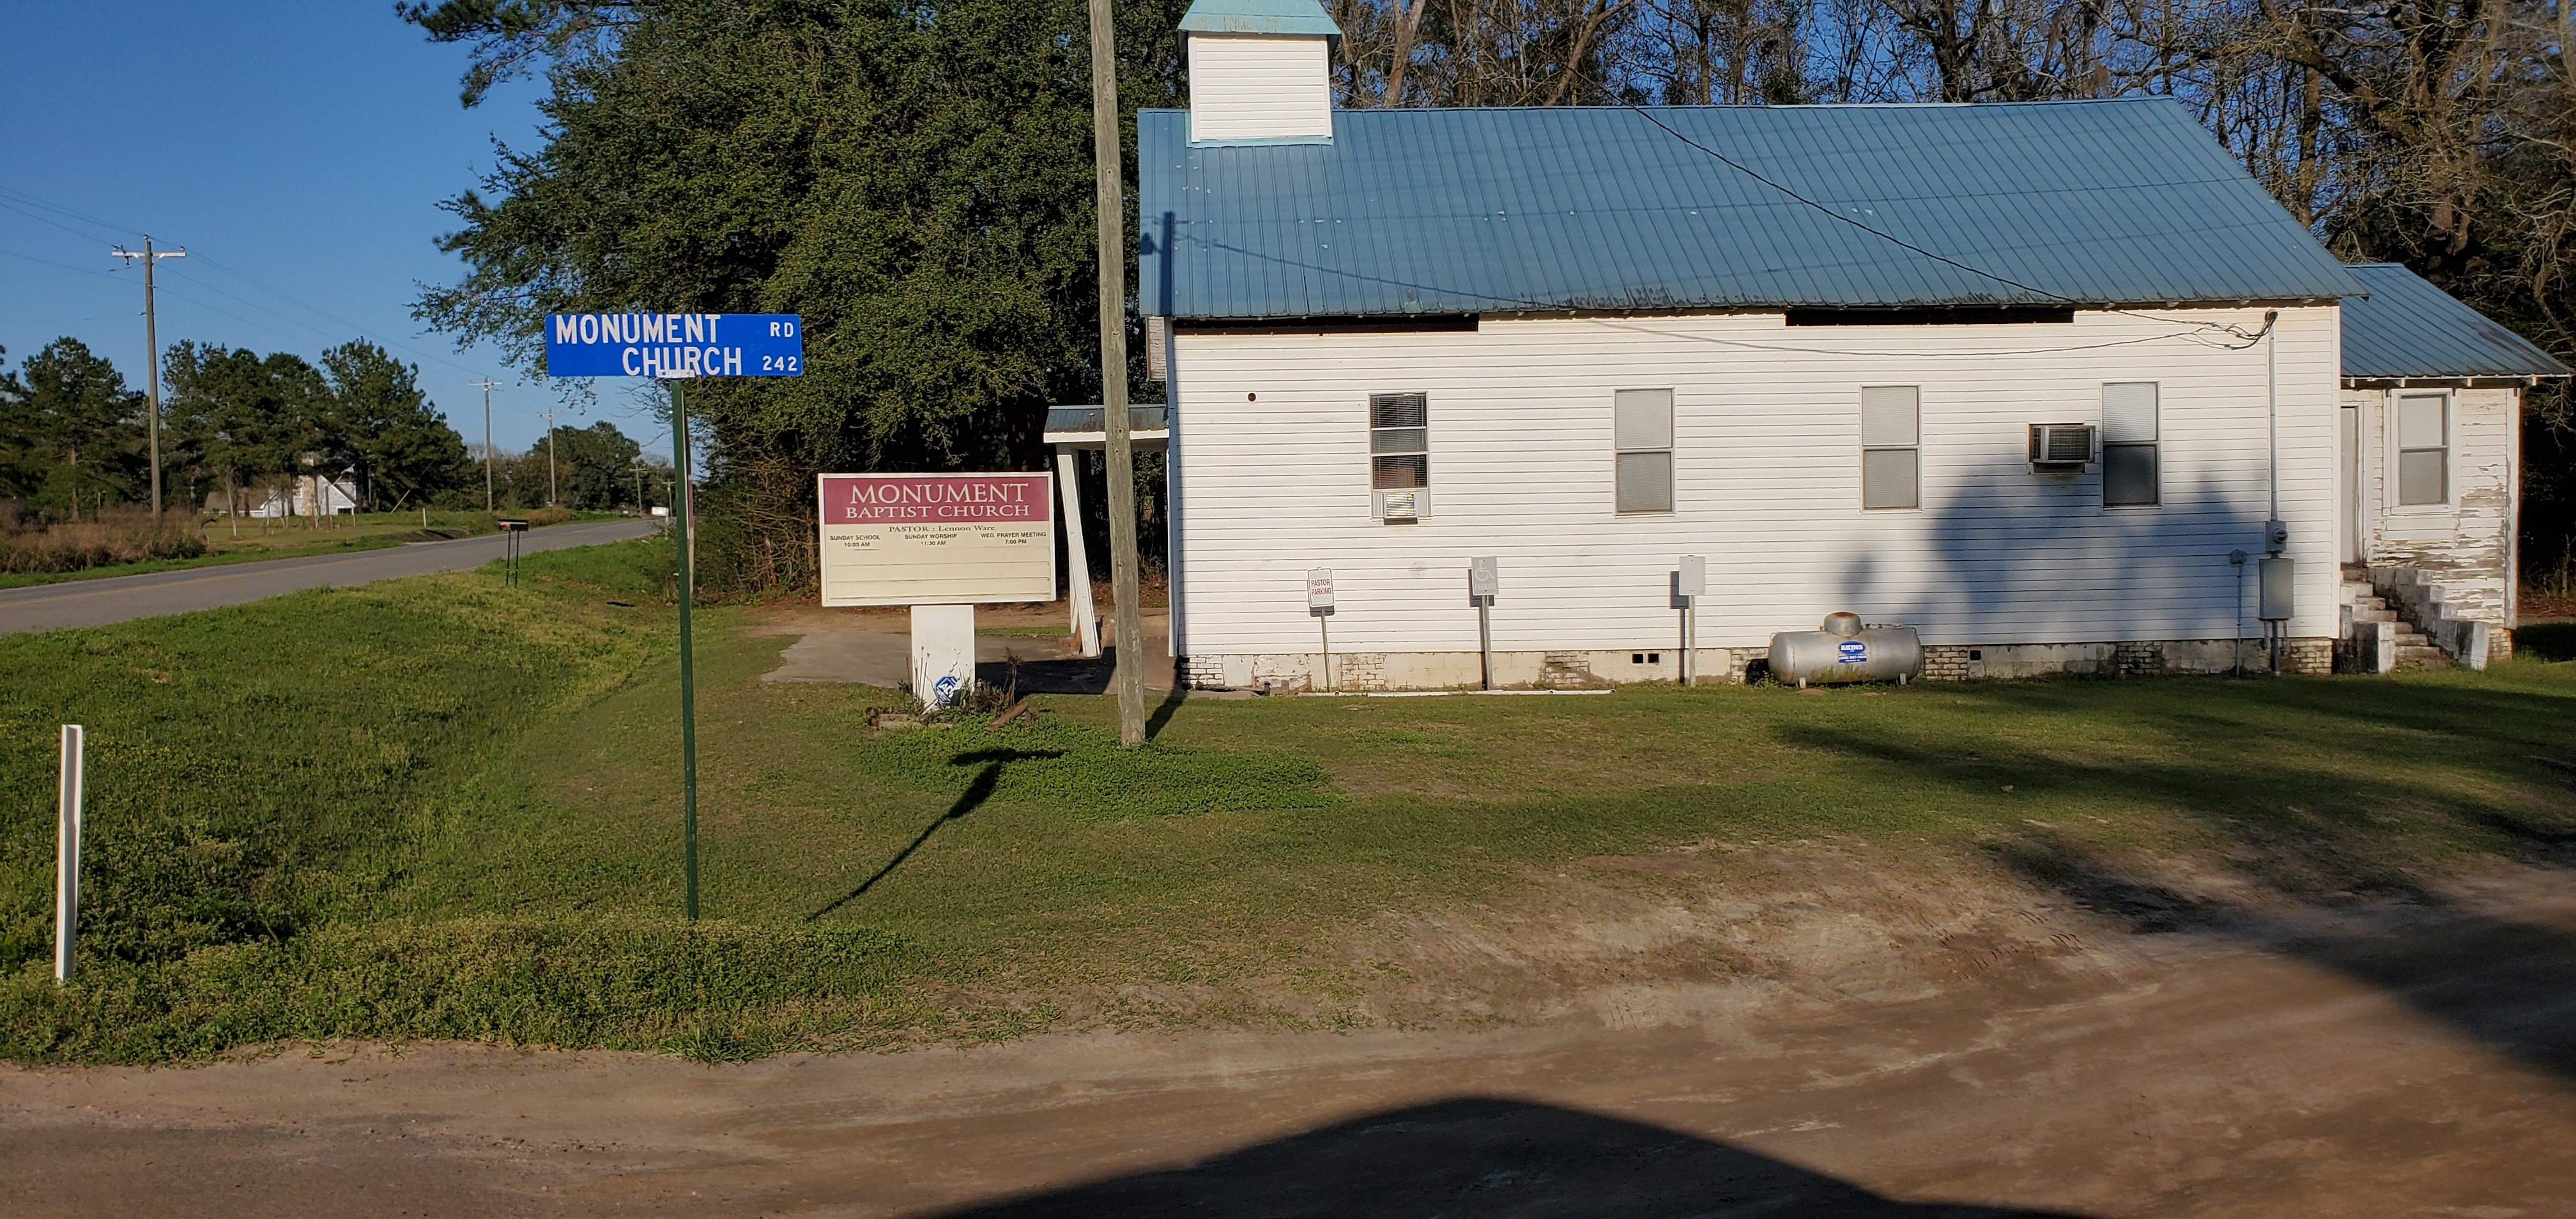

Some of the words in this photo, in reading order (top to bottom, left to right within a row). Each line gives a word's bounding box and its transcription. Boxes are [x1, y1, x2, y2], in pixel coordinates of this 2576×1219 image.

[556, 314, 721, 344] MONUMENT
[770, 321, 794, 337] RD
[622, 346, 742, 376] CHURCH
[762, 355, 797, 371] 242
[850, 483, 1029, 504] MONUMENT
[845, 506, 932, 518] BAPTIST
[938, 505, 1030, 517] CHURCH
[1312, 587, 1331, 595] PARKING
